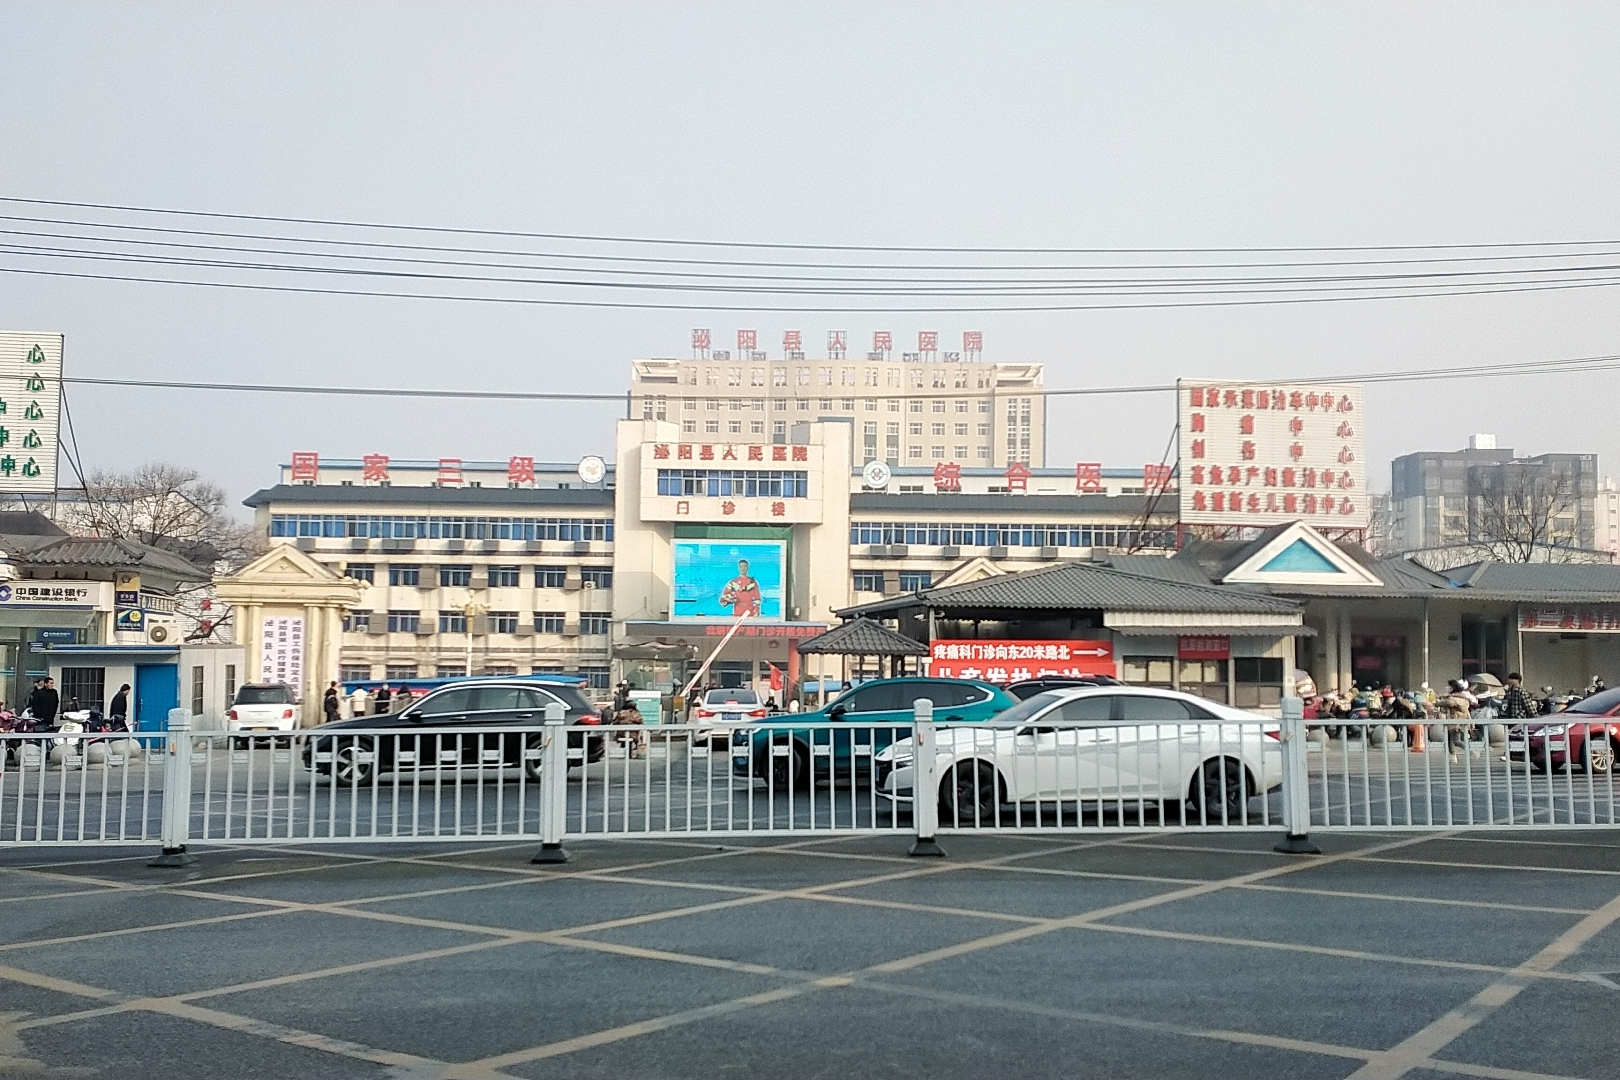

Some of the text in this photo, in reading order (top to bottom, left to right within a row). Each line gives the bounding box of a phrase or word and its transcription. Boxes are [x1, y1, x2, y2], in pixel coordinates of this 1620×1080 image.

[692, 329, 983, 351] 泌阳县人民医院
[26, 343, 45, 363] 心
[26, 372, 45, 392] 心
[653, 444, 808, 461] 泌阳县人民医院
[1, 455, 41, 477] 中心
[291, 452, 1172, 490] 国家三级 综合医院
[677, 501, 786, 516] 门诊楼
[15, 587, 88, 597] 中国建设银行
[934, 644, 1070, 660] 疼痛科门诊向东20米路北
